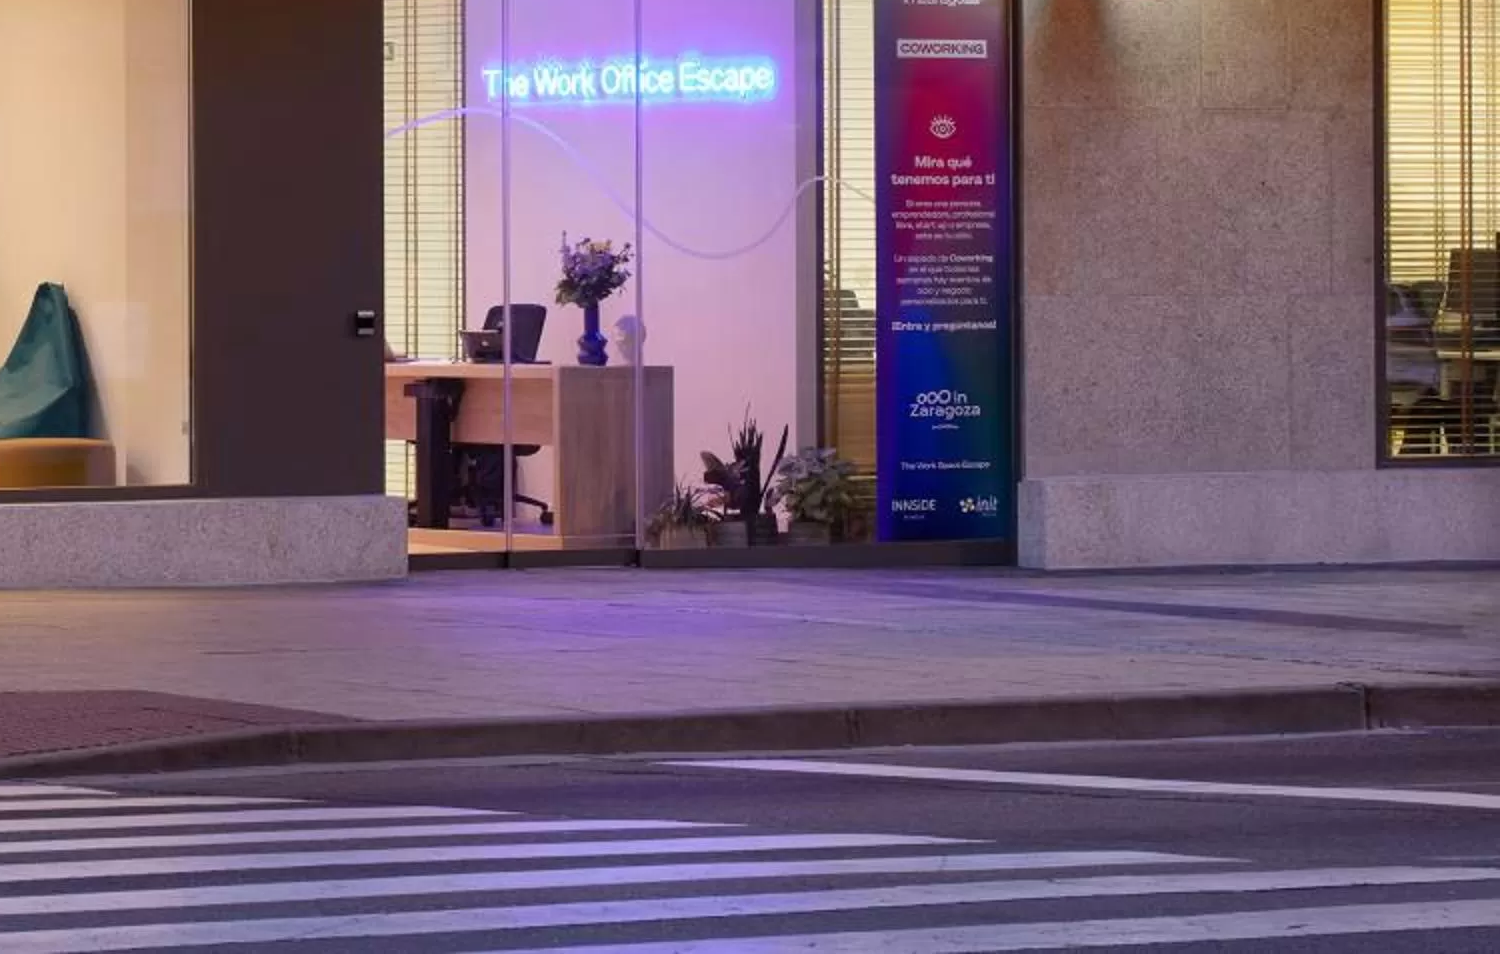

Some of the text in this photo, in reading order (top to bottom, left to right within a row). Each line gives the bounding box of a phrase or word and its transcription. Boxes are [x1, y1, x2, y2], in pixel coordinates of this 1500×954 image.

[900, 42, 985, 55] COWORKING
[533, 66, 596, 97] Work
[678, 61, 774, 97] Escape
[914, 155, 973, 172] Mira qué
[891, 173, 951, 186] tenemos
[952, 175, 983, 189] para
[953, 390, 968, 404] in
[909, 404, 981, 420] Zaragoza
